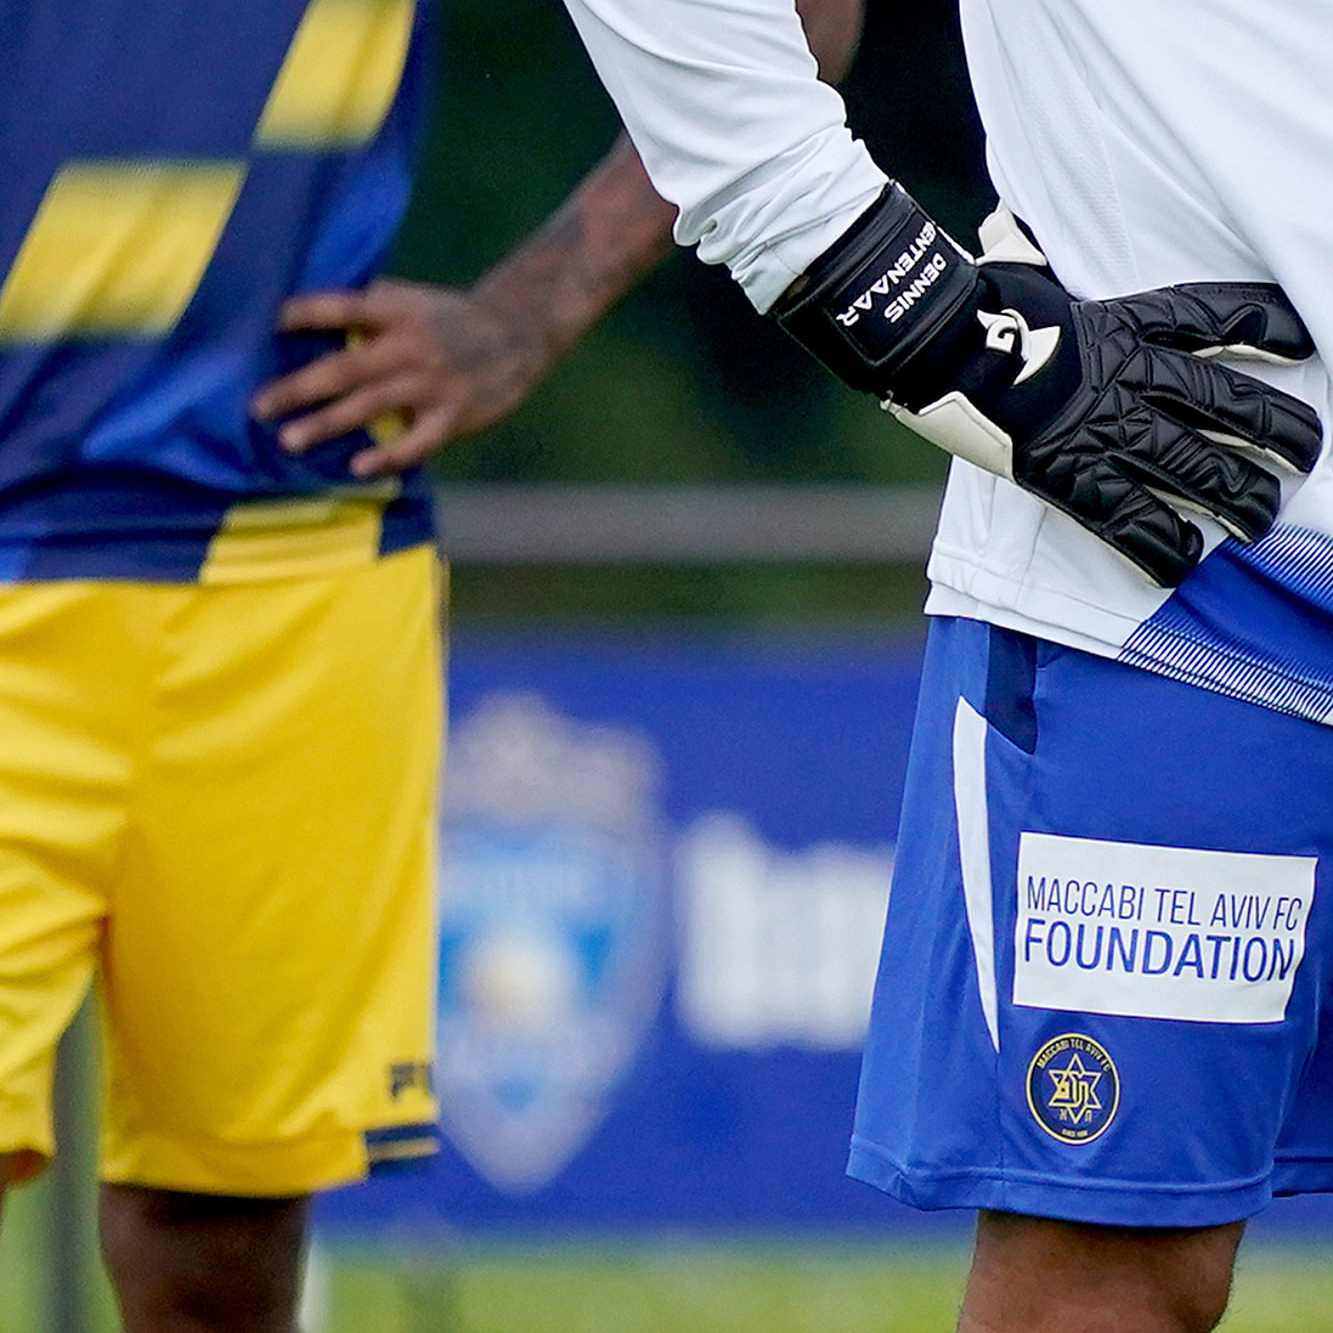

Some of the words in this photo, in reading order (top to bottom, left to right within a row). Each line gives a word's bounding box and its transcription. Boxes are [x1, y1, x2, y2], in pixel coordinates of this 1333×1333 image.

[884, 252, 947, 323] DENNIS
[1027, 875, 1145, 920] MACCABI
[1154, 888, 1201, 926] TEL
[1210, 893, 1271, 930] AVIV
[1272, 897, 1303, 931] FC
[1024, 917, 1294, 982] FOUNDATION
